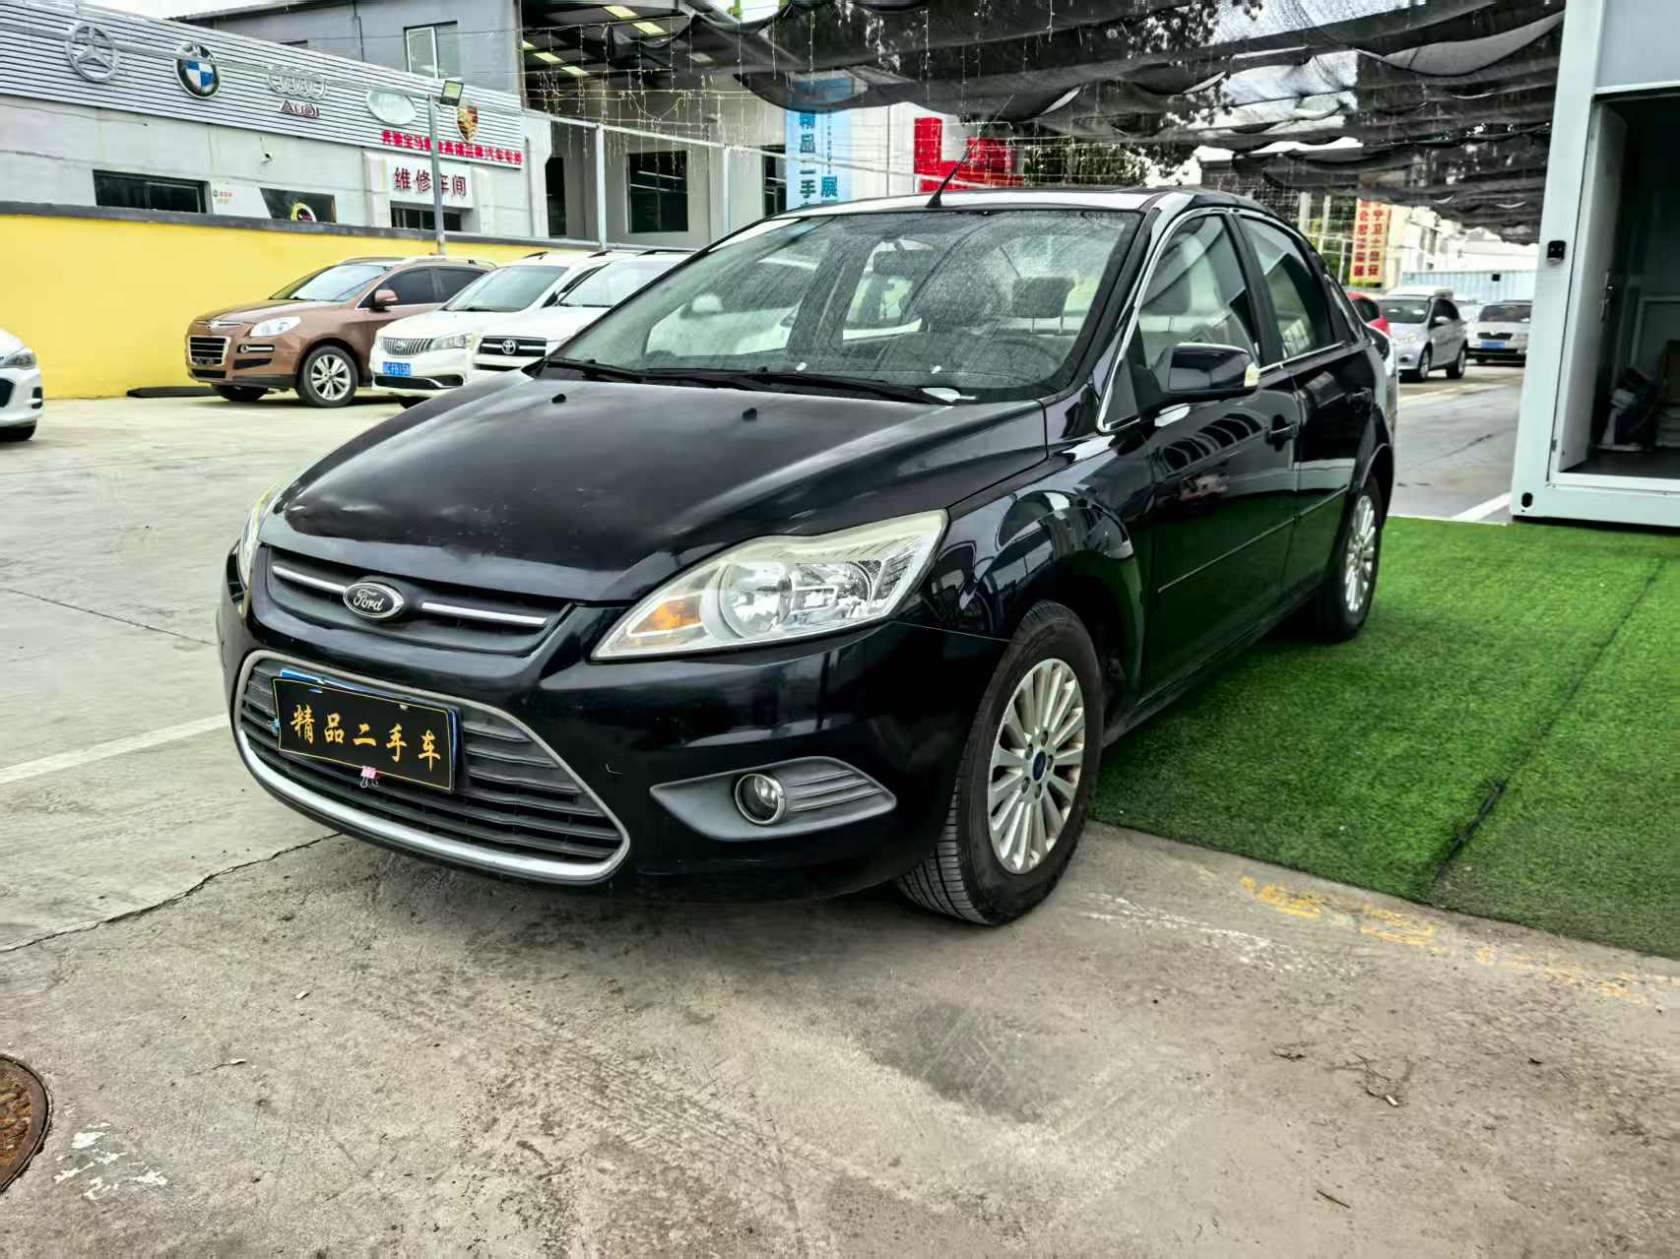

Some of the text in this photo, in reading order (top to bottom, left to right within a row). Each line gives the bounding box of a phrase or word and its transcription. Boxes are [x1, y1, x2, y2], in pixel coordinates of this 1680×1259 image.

[394, 167, 466, 196] 维修车间
[799, 110, 816, 207] 精品二手
[353, 588, 385, 612] Ford
[290, 704, 441, 773] 精品二手车
